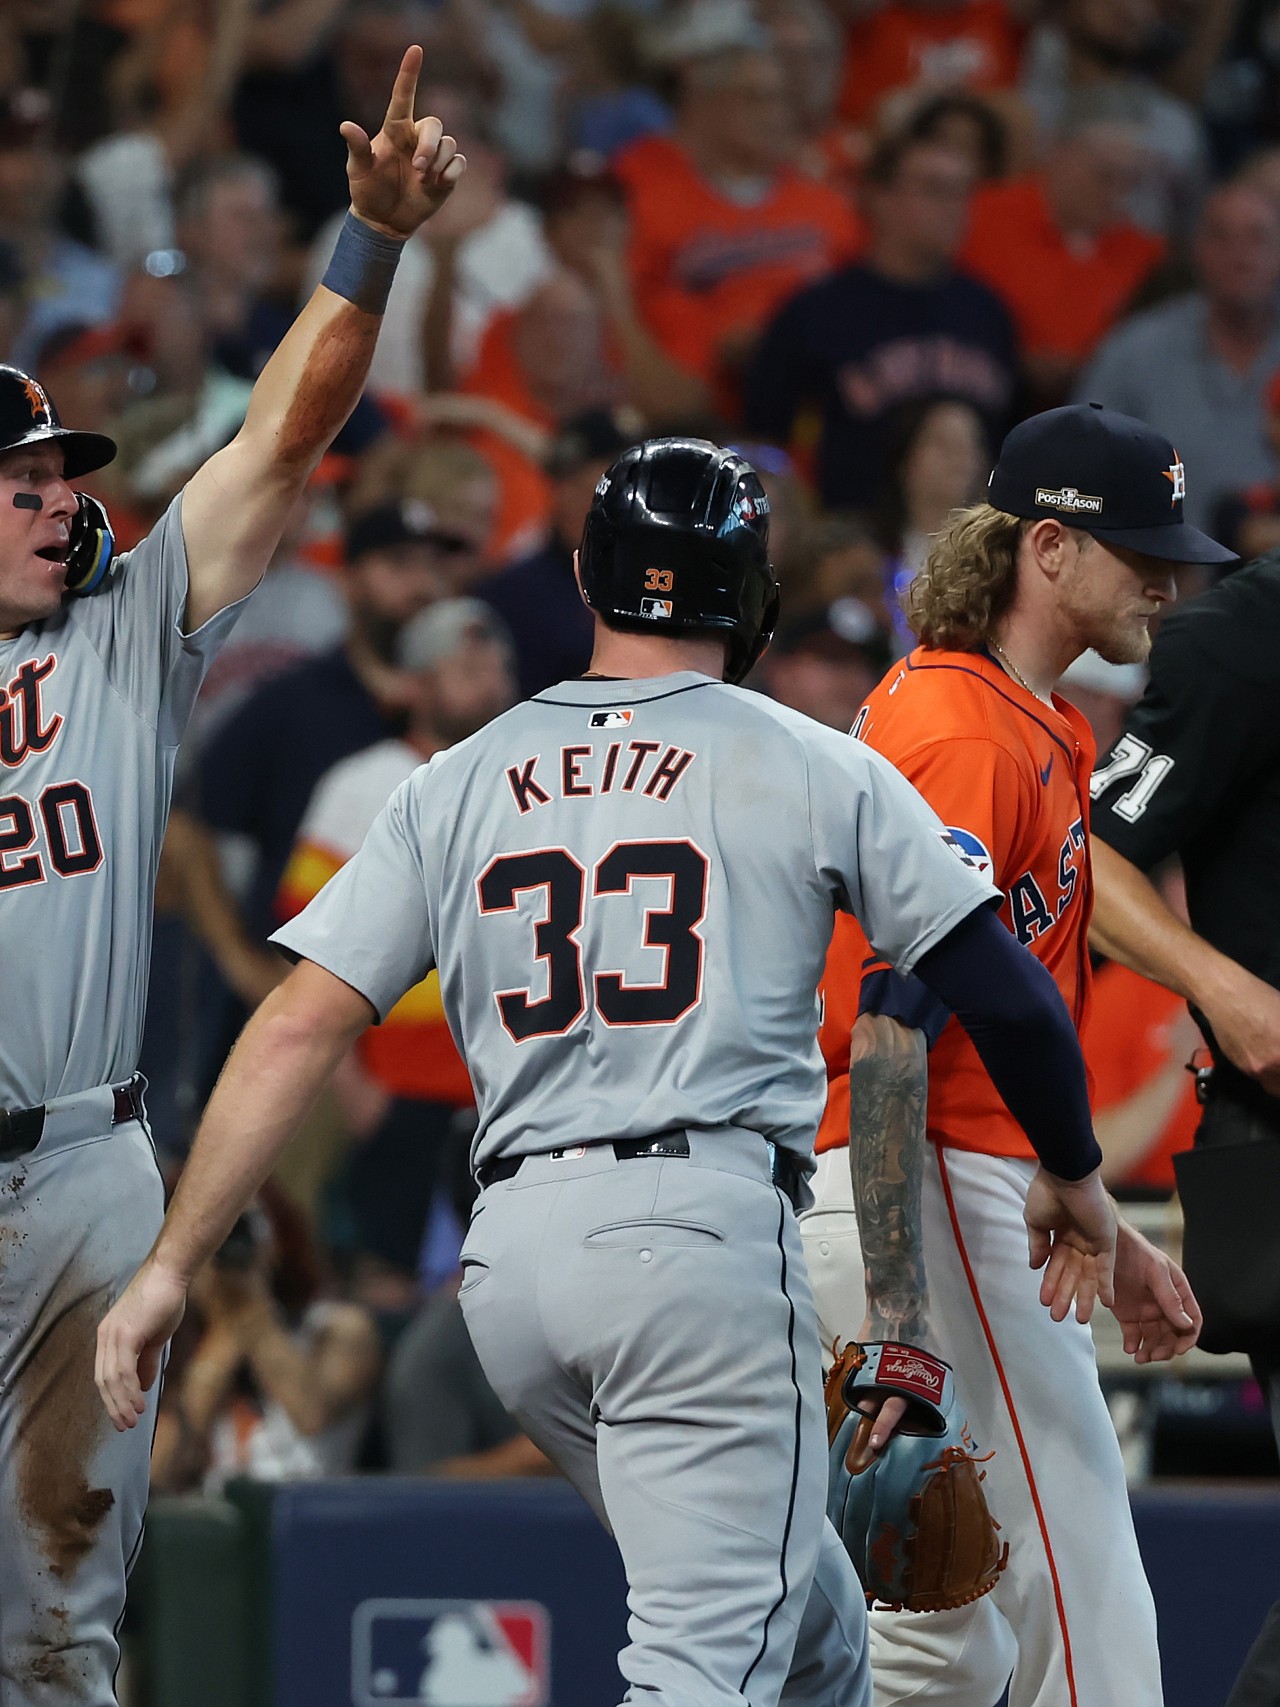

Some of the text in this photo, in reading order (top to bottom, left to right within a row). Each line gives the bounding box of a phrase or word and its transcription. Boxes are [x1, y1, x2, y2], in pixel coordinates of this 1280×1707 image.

[1037, 491, 1100, 511] POSTSEASON
[644, 567, 674, 592] 33
[504, 739, 697, 816] KEITH
[1090, 732, 1176, 824] 71
[474, 836, 712, 1047] 33
[884, 1359, 940, 1388] Rawlings
